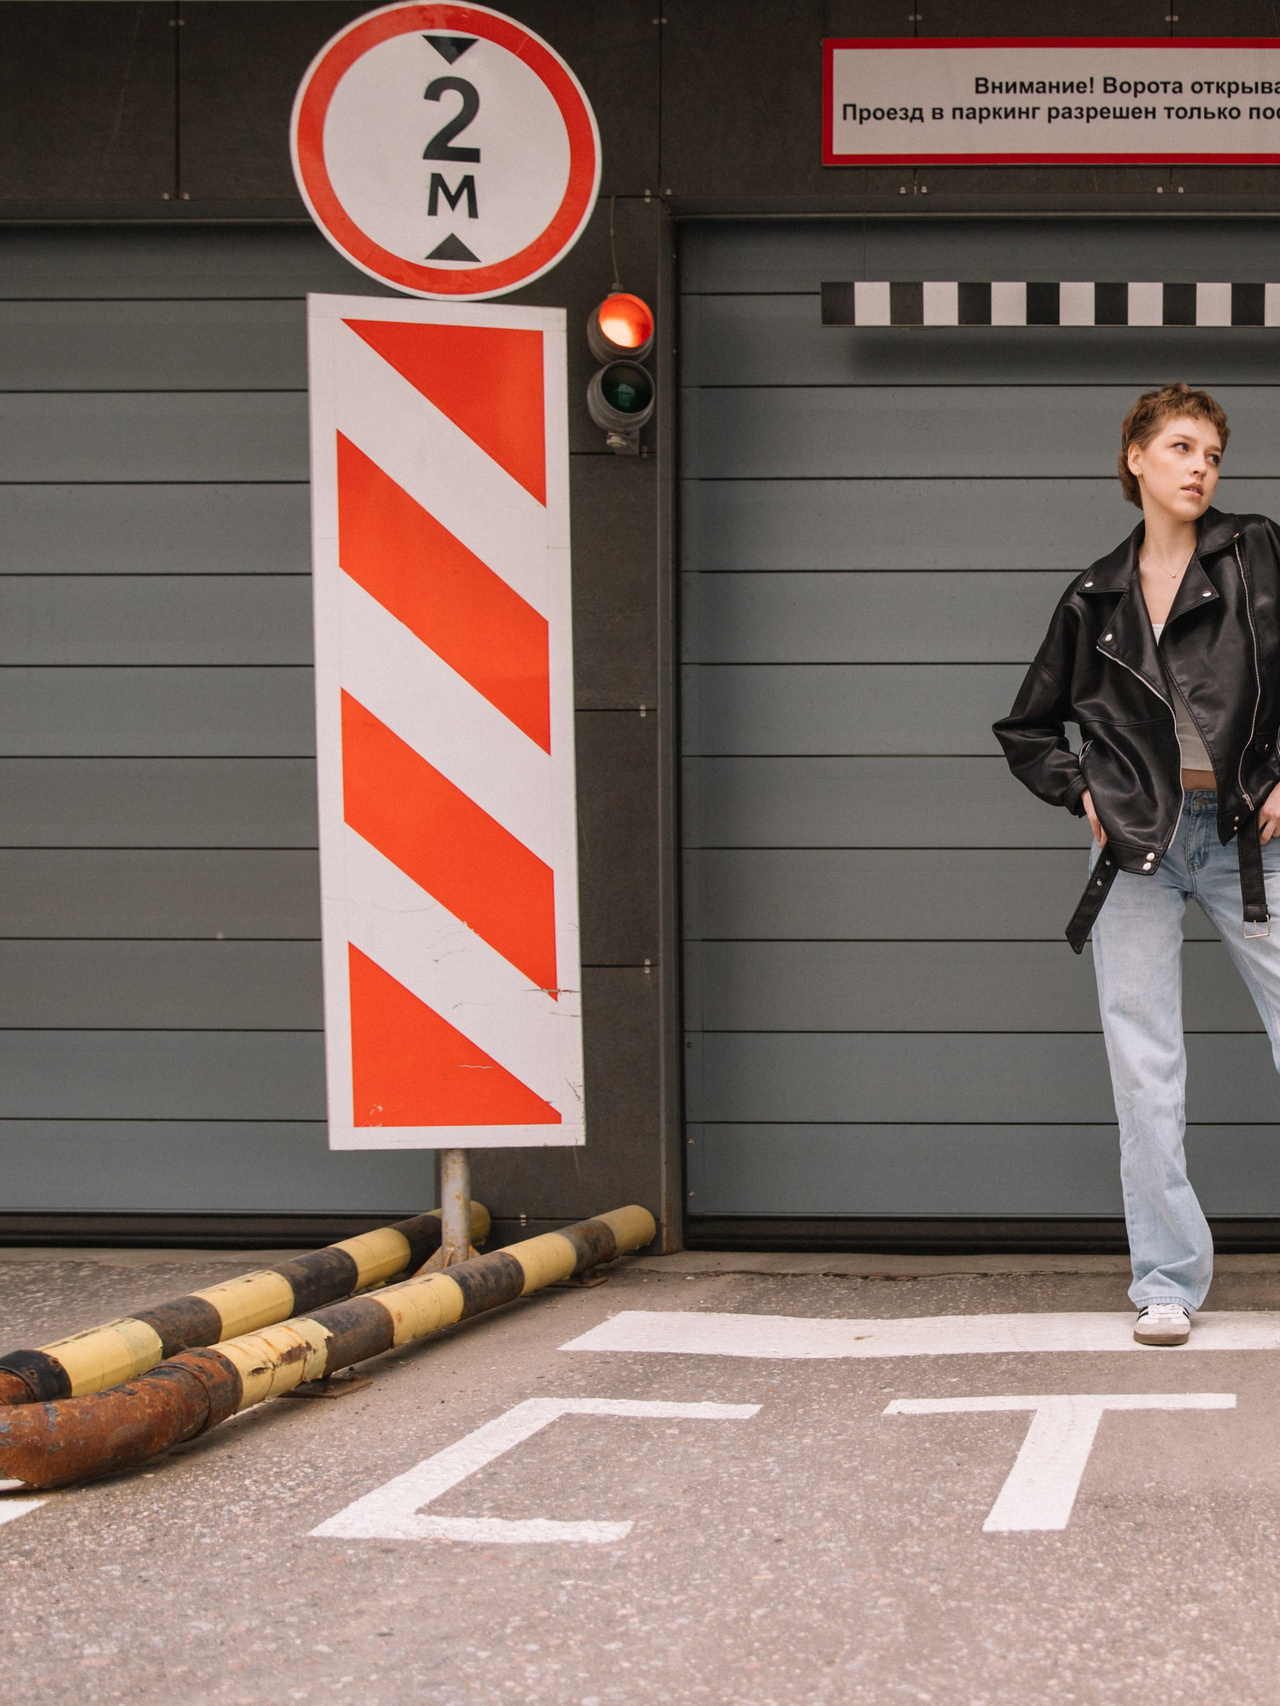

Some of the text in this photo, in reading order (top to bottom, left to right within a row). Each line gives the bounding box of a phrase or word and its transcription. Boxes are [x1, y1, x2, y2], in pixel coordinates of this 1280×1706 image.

[975, 77, 1093, 94] Внимание!
[1103, 77, 1182, 98] Ворота
[423, 76, 480, 163] 2
[843, 104, 924, 125] Проезд
[932, 108, 944, 120] в
[952, 107, 1040, 124] паркинг
[1048, 107, 1156, 123] разрешен
[1164, 107, 1241, 119] только
